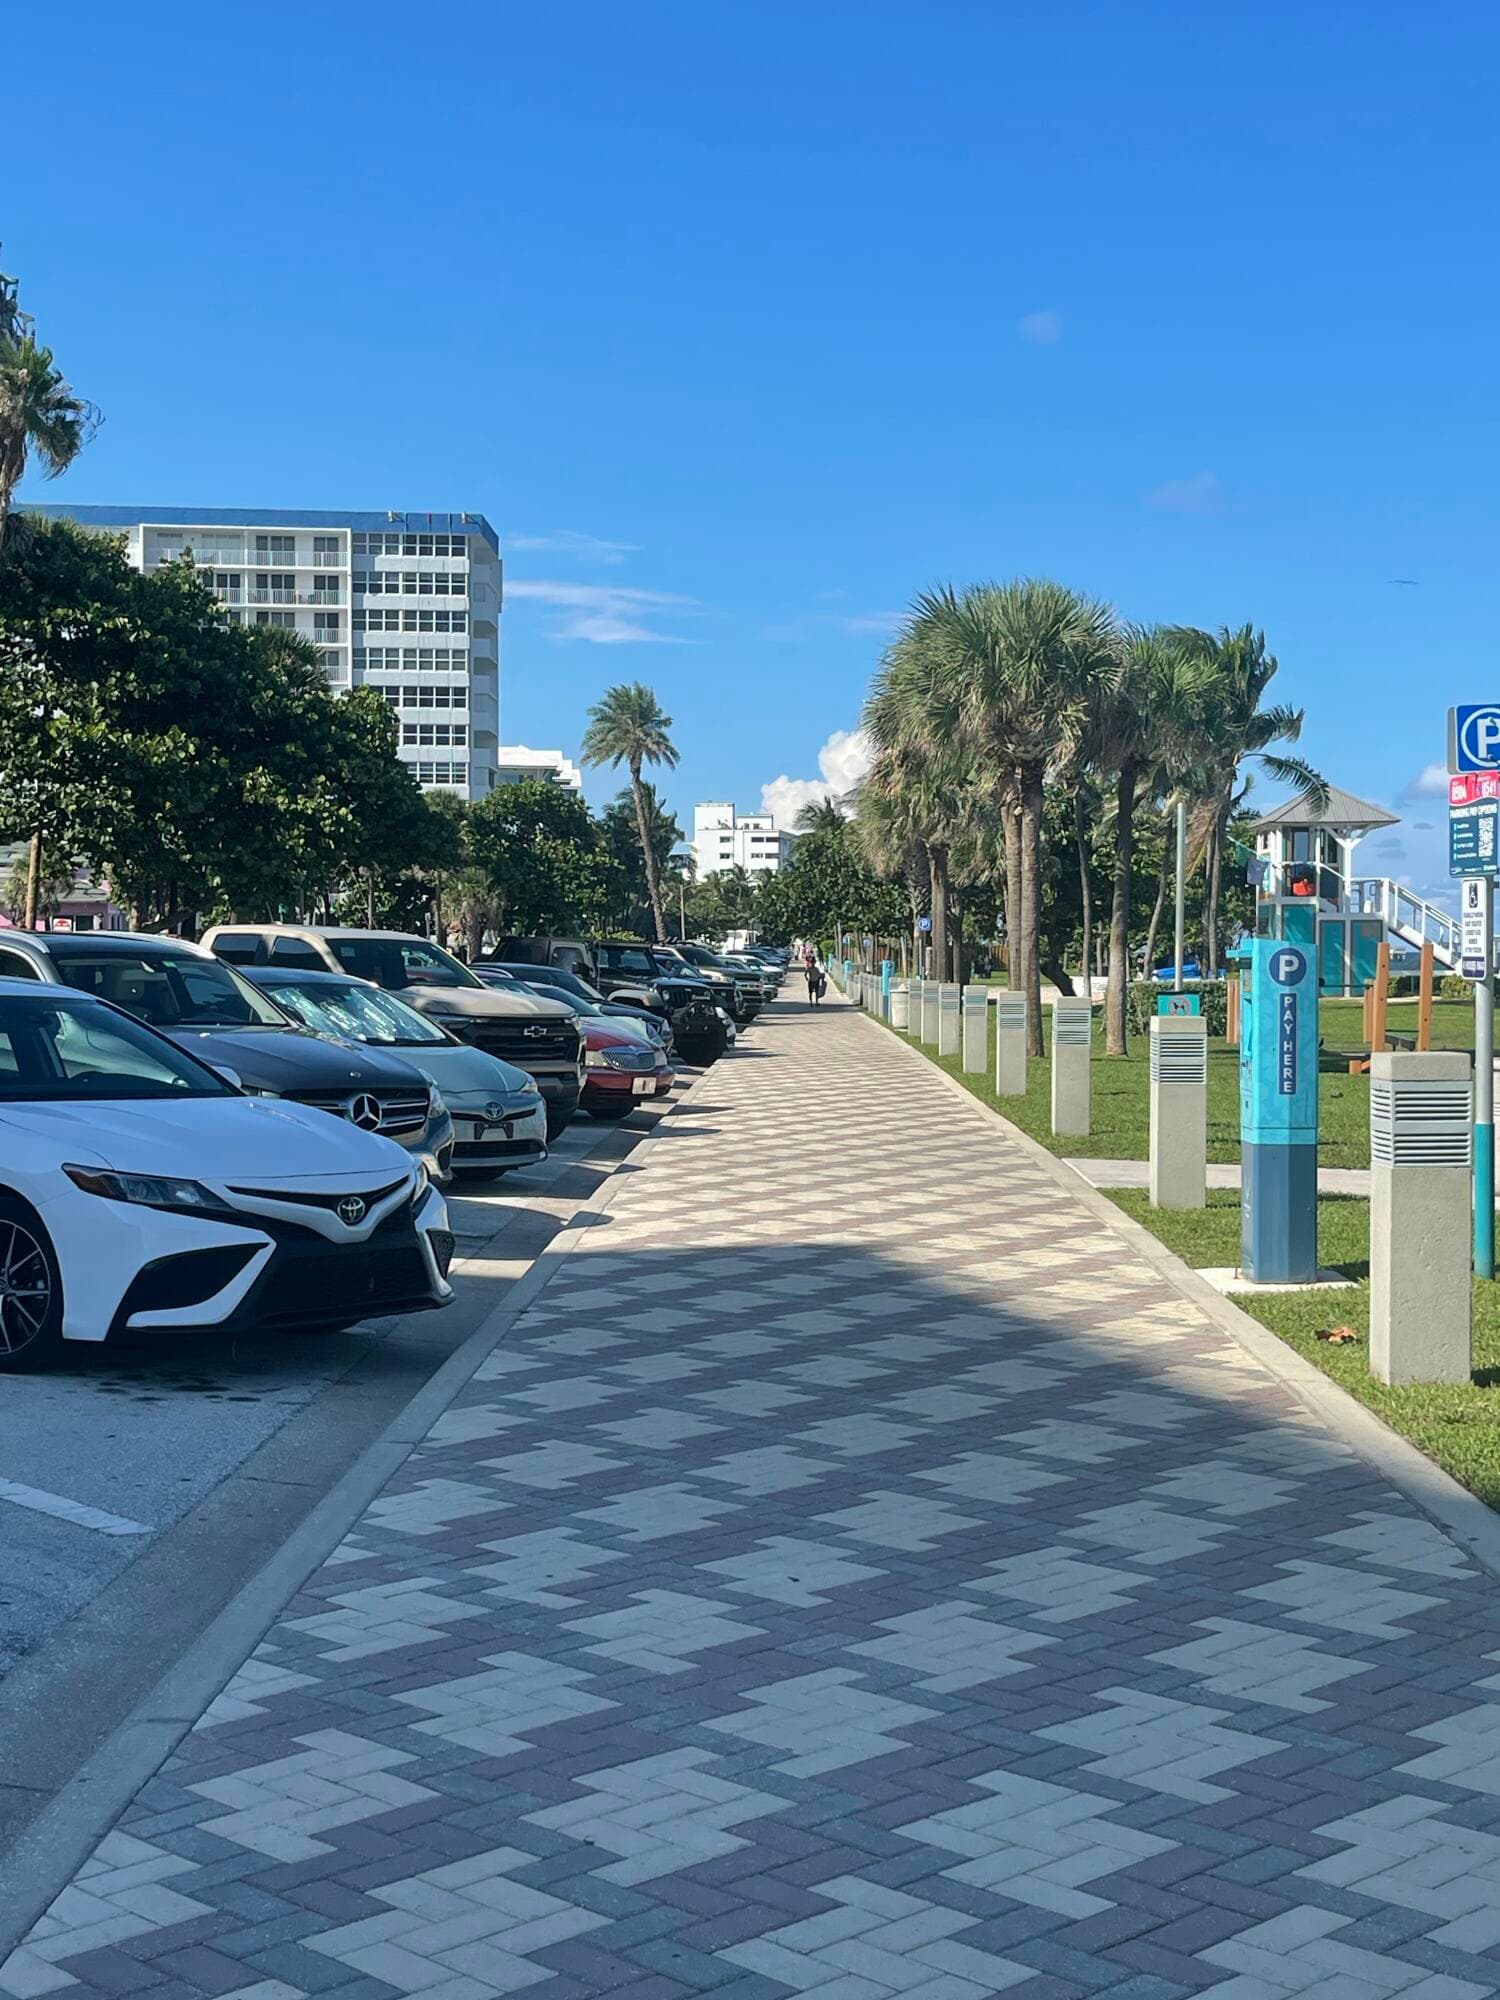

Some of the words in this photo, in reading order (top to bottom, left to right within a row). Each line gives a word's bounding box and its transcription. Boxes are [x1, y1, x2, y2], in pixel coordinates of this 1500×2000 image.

[1477, 718, 1500, 758] P
[1279, 955, 1299, 981] P
[1283, 997, 1294, 1035] PAY
[1283, 1041, 1293, 1093] HERE
